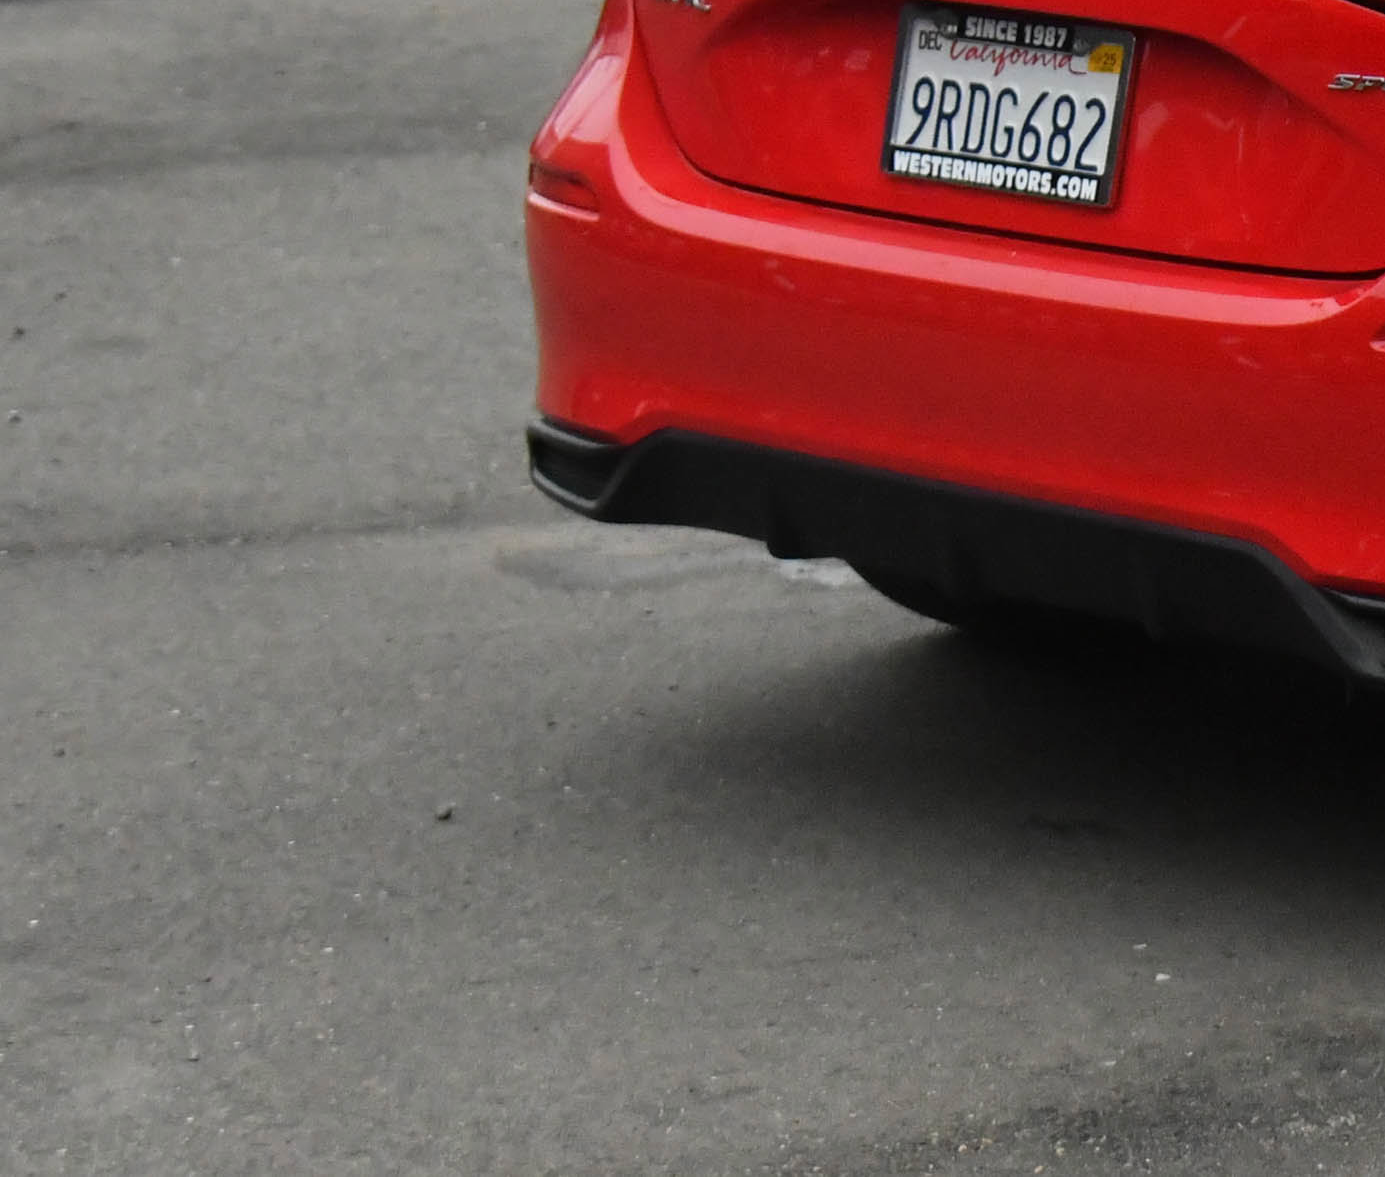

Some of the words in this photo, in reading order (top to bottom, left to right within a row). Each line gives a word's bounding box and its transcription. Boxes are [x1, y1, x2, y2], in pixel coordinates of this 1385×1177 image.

[918, 29, 943, 51] DEC
[964, 16, 1017, 42] SINCE
[1023, 24, 1068, 49] 1987
[950, 39, 1087, 78] California
[1102, 52, 1118, 67] 25
[905, 76, 1107, 172] 9RDG682
[893, 150, 1099, 202] WESTERNMOTORS.COM
